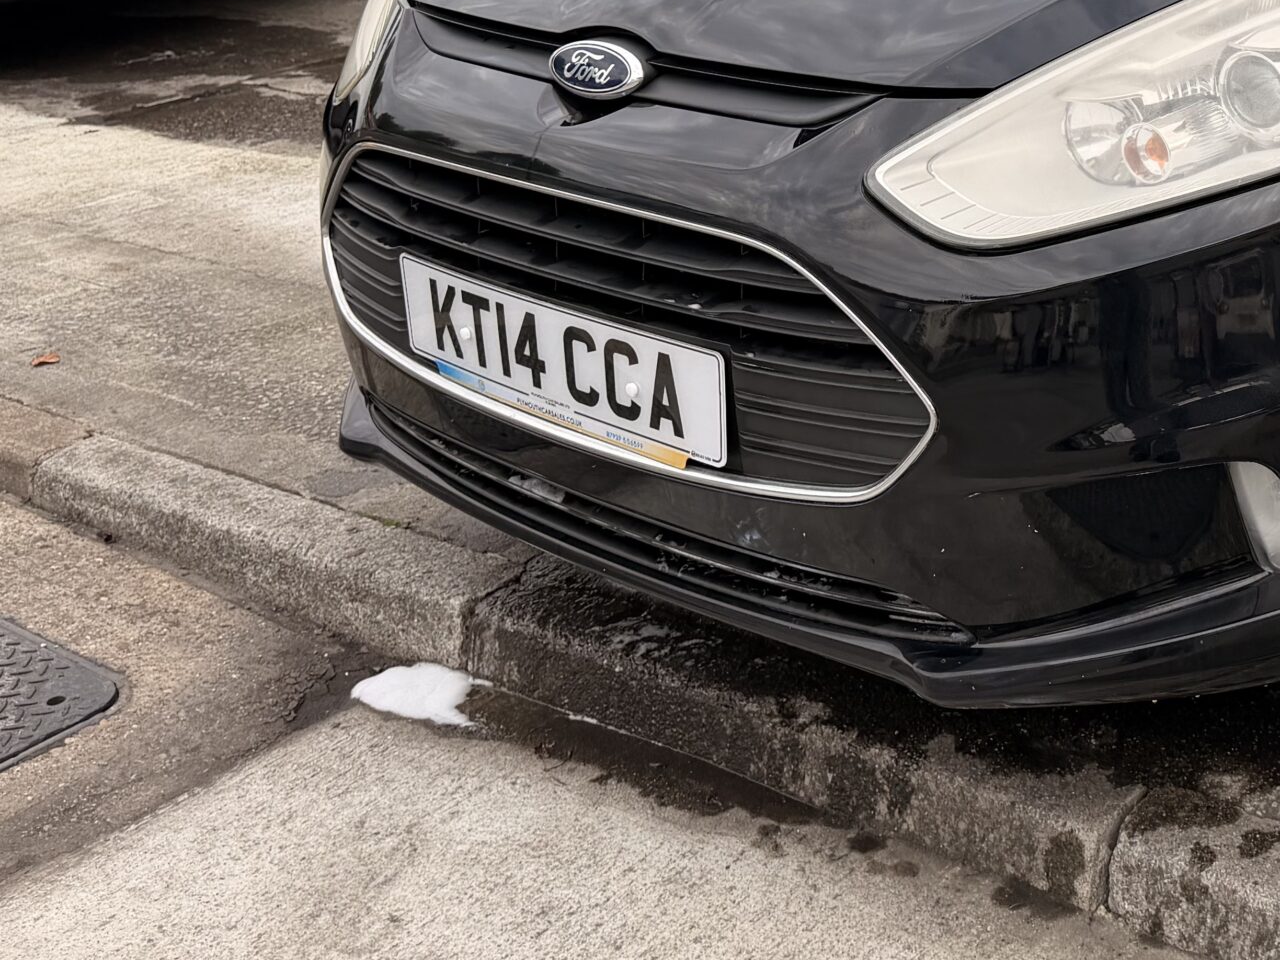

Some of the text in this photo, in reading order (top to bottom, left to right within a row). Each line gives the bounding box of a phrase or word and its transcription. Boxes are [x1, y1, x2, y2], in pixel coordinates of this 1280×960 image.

[564, 50, 615, 85] Ford
[429, 278, 684, 439] KT14 CCA
